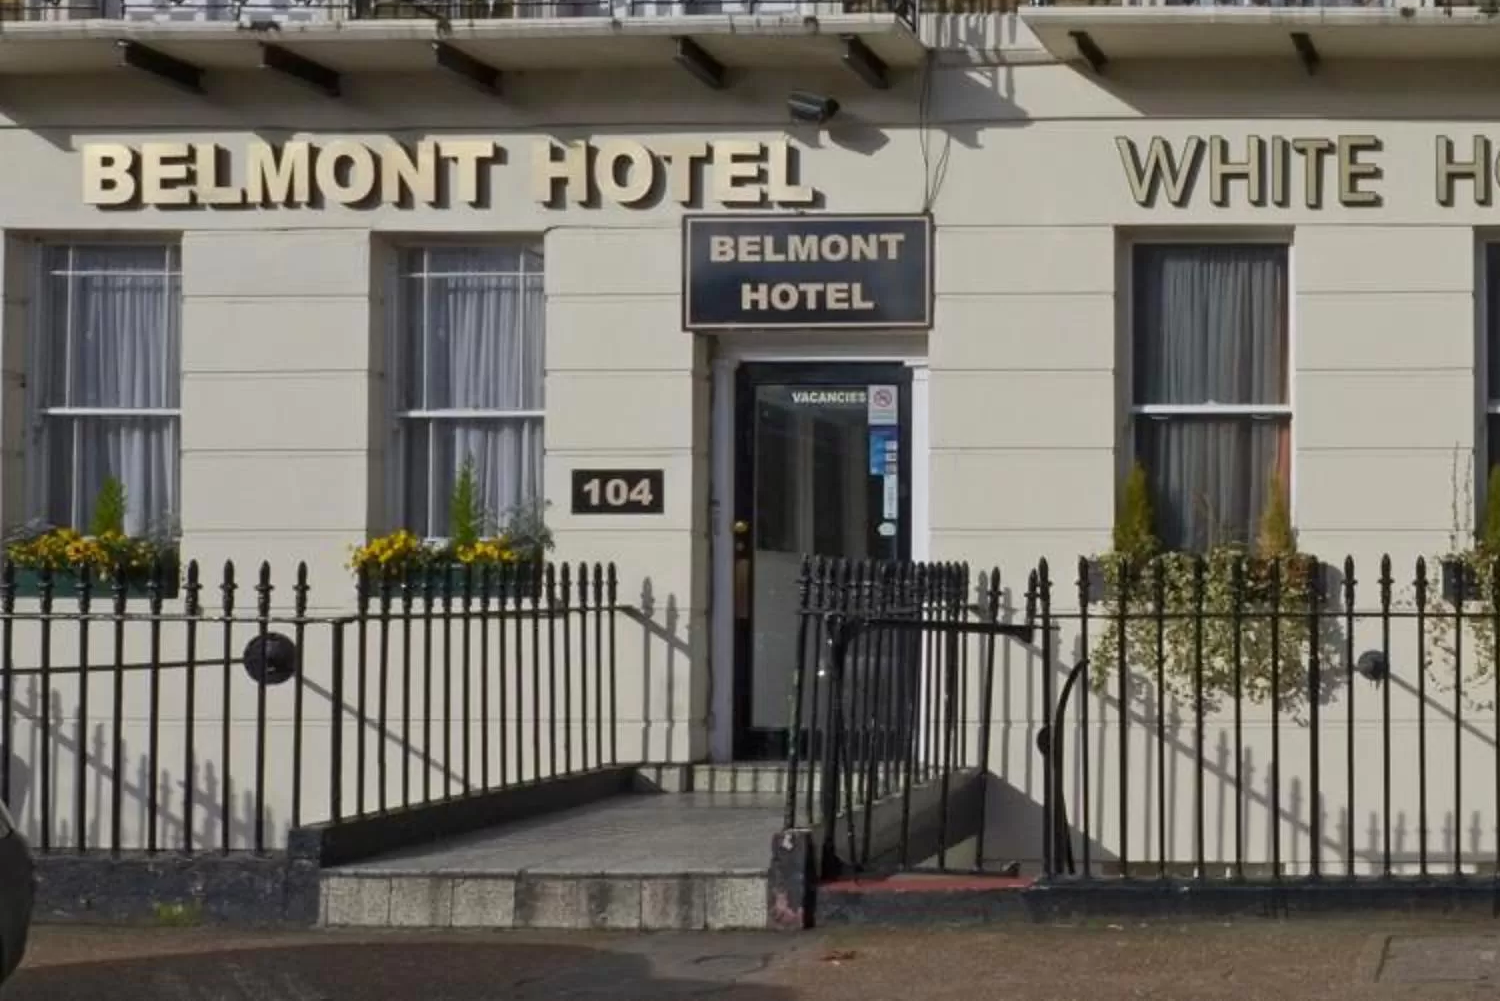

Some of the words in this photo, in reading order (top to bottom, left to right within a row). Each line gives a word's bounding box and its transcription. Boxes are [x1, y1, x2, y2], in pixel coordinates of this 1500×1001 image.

[82, 140, 501, 206] BELMONT
[534, 138, 818, 205] HOTEL
[1115, 133, 1384, 209] WHITE
[709, 233, 906, 263] BELMONT
[740, 281, 876, 312] HOTEL
[791, 390, 866, 404] VACANCIES
[583, 478, 653, 506] 104
